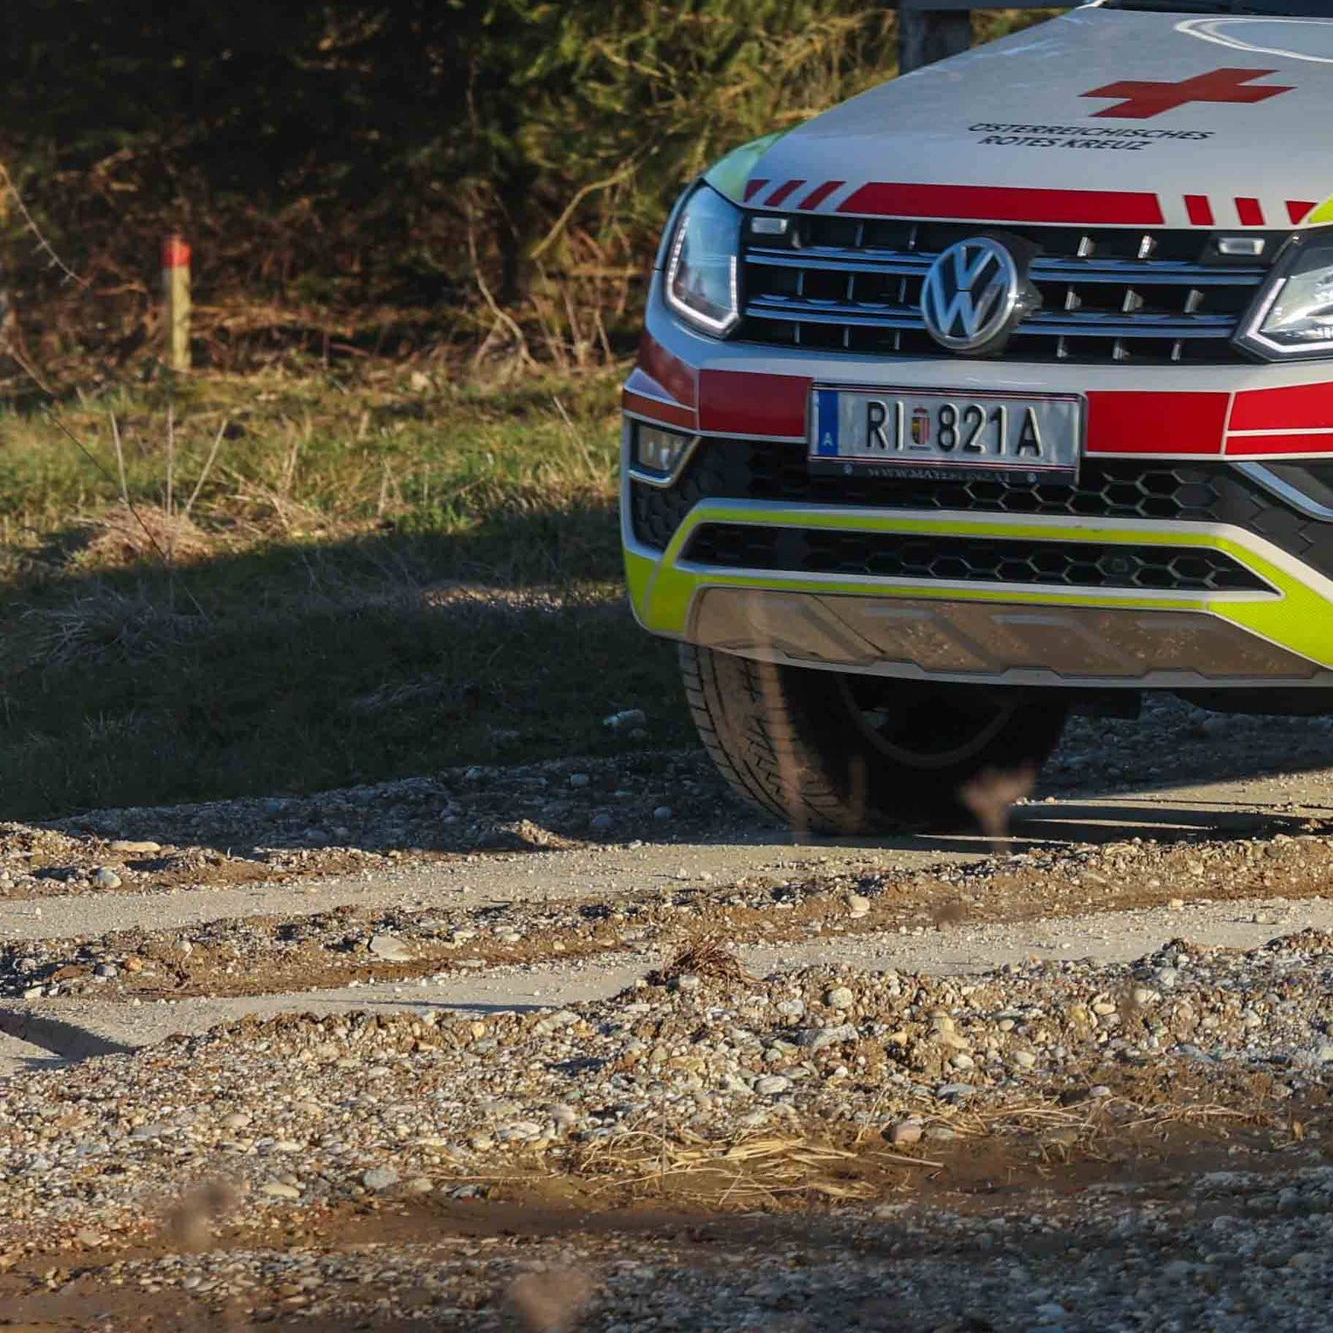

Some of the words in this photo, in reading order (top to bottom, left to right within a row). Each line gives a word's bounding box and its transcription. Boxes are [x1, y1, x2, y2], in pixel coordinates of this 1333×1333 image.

[977, 135, 1062, 148] ROTES
[1060, 138, 1153, 151] KREUZ
[866, 400, 904, 451] RI
